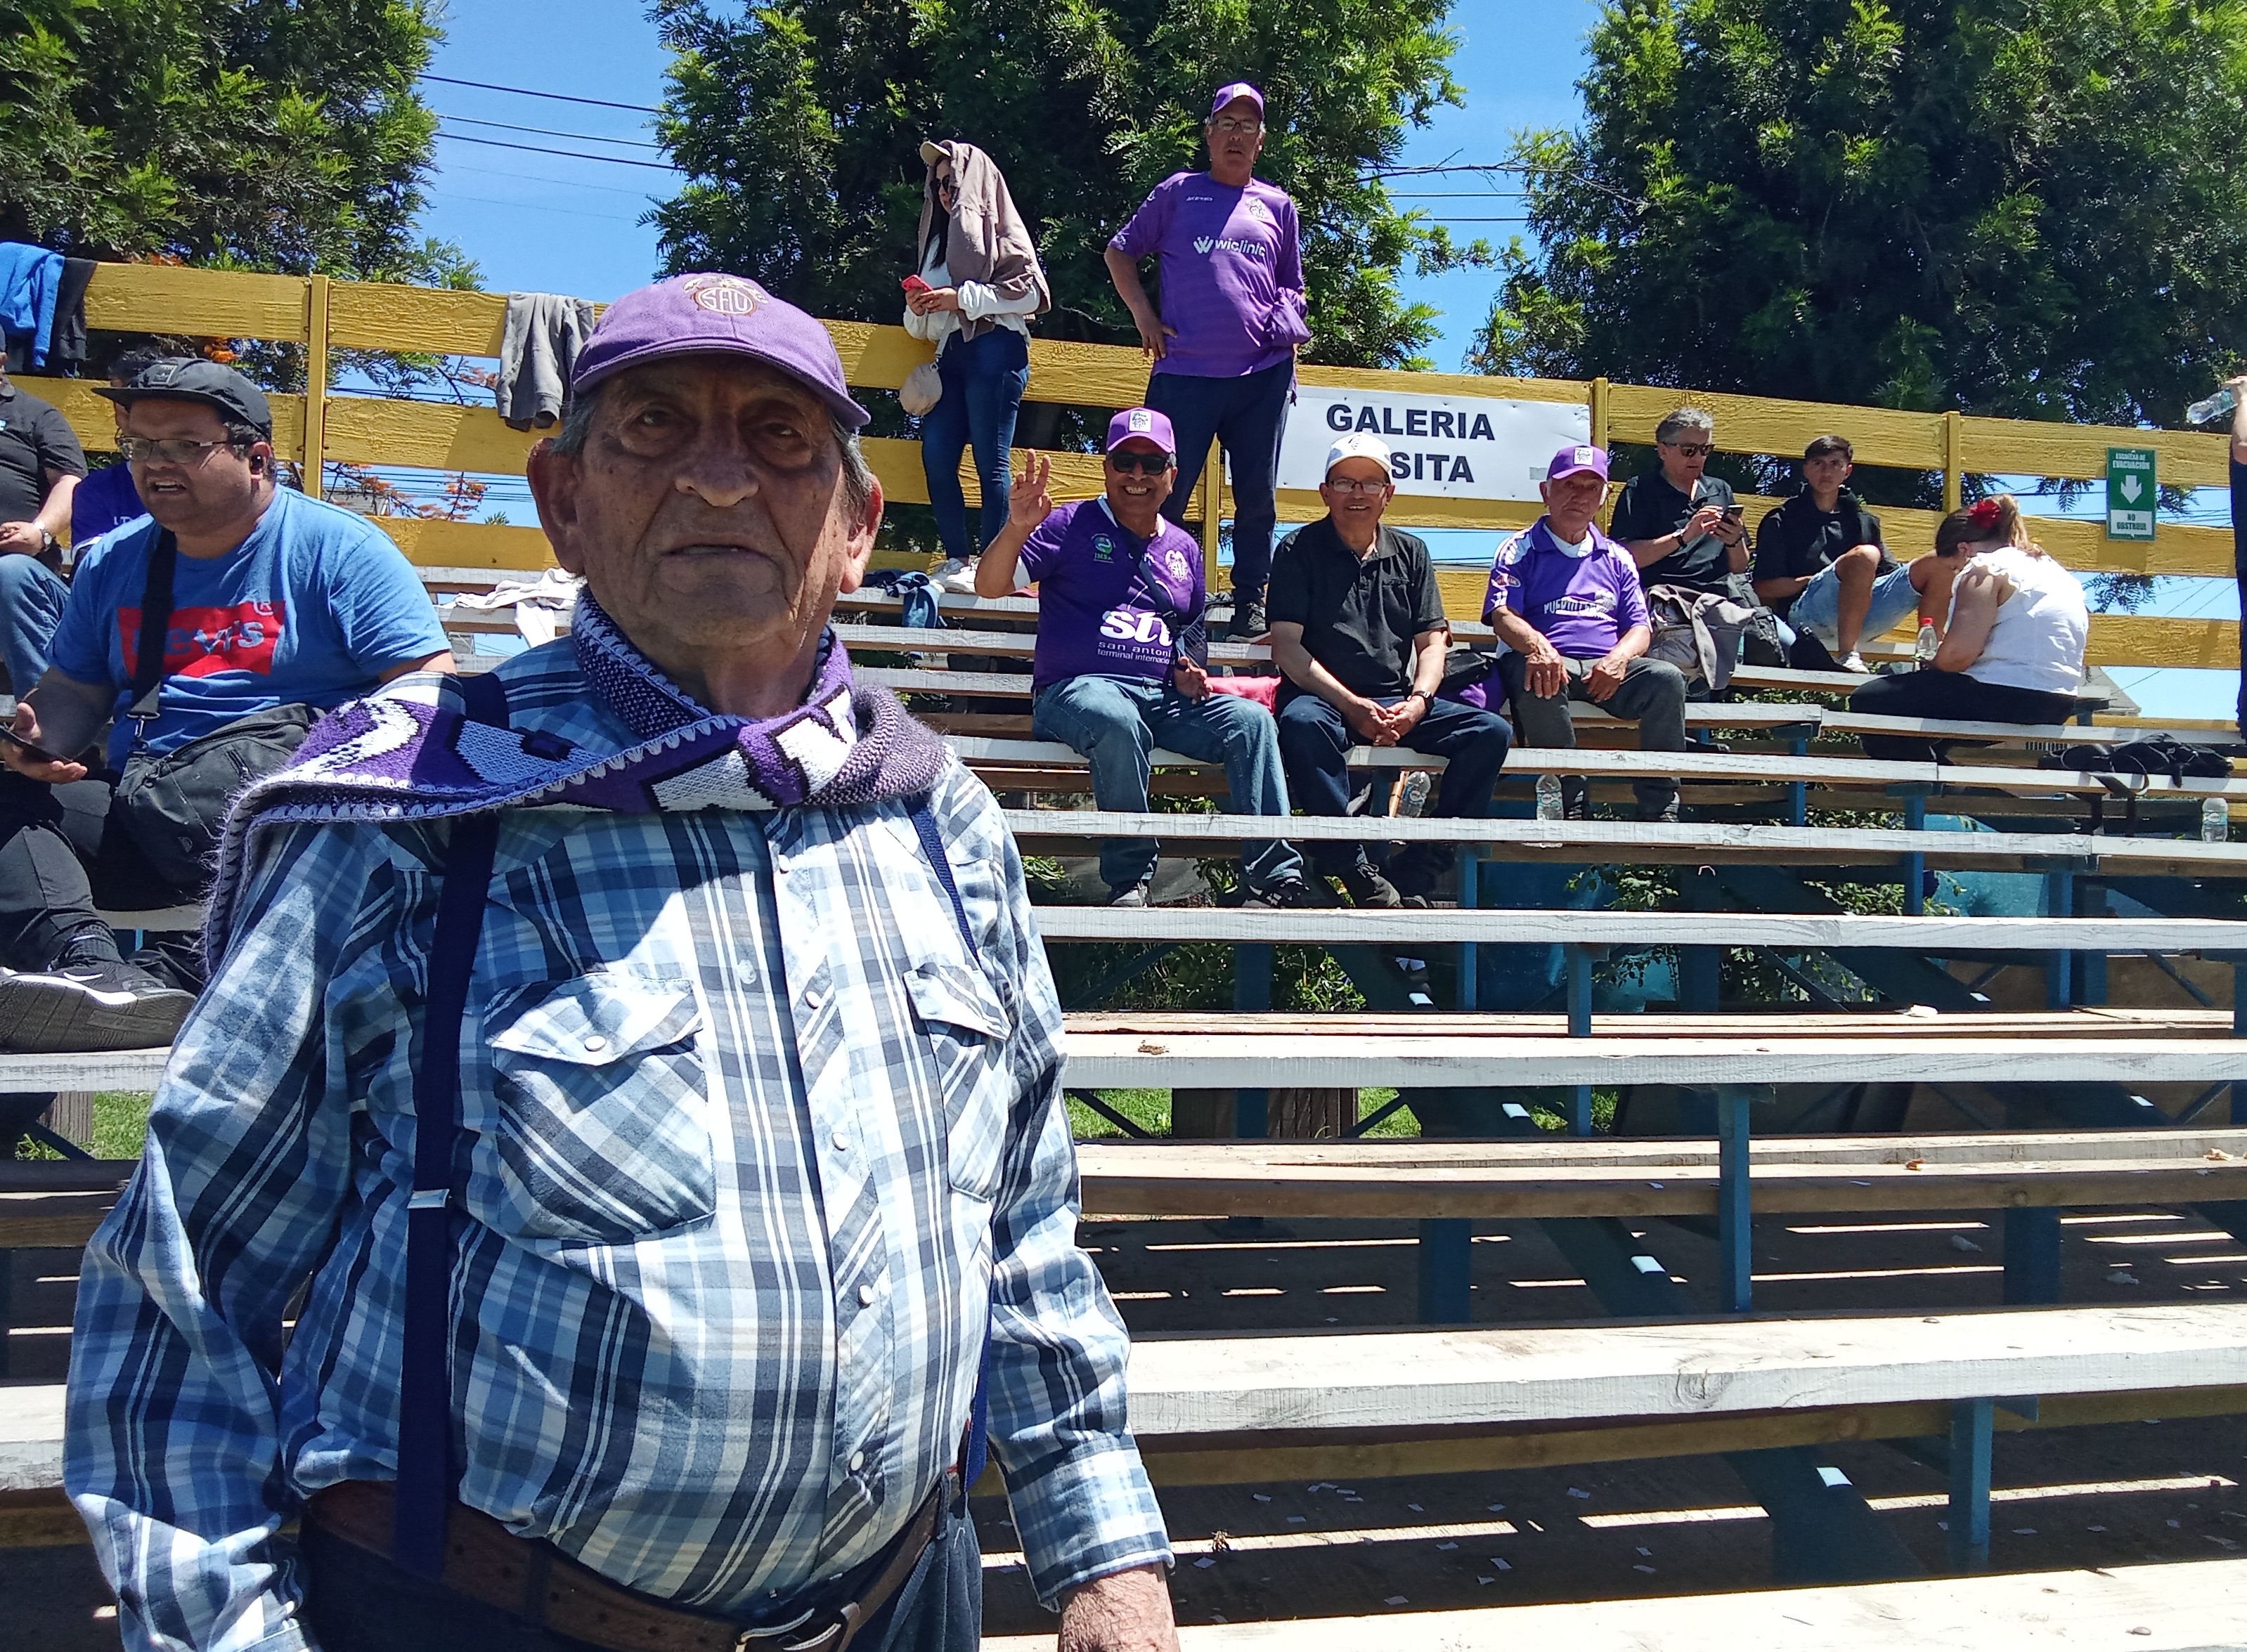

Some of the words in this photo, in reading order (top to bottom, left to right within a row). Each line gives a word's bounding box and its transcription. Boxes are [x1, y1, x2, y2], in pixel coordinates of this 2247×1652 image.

[1215, 238, 1266, 256] wiclinic
[701, 288, 749, 311] SAU
[1326, 403, 1496, 441] GALERIA
[1390, 451, 1475, 483] SITA
[1097, 648, 1133, 660] terminal
[1098, 642, 1126, 651] san
